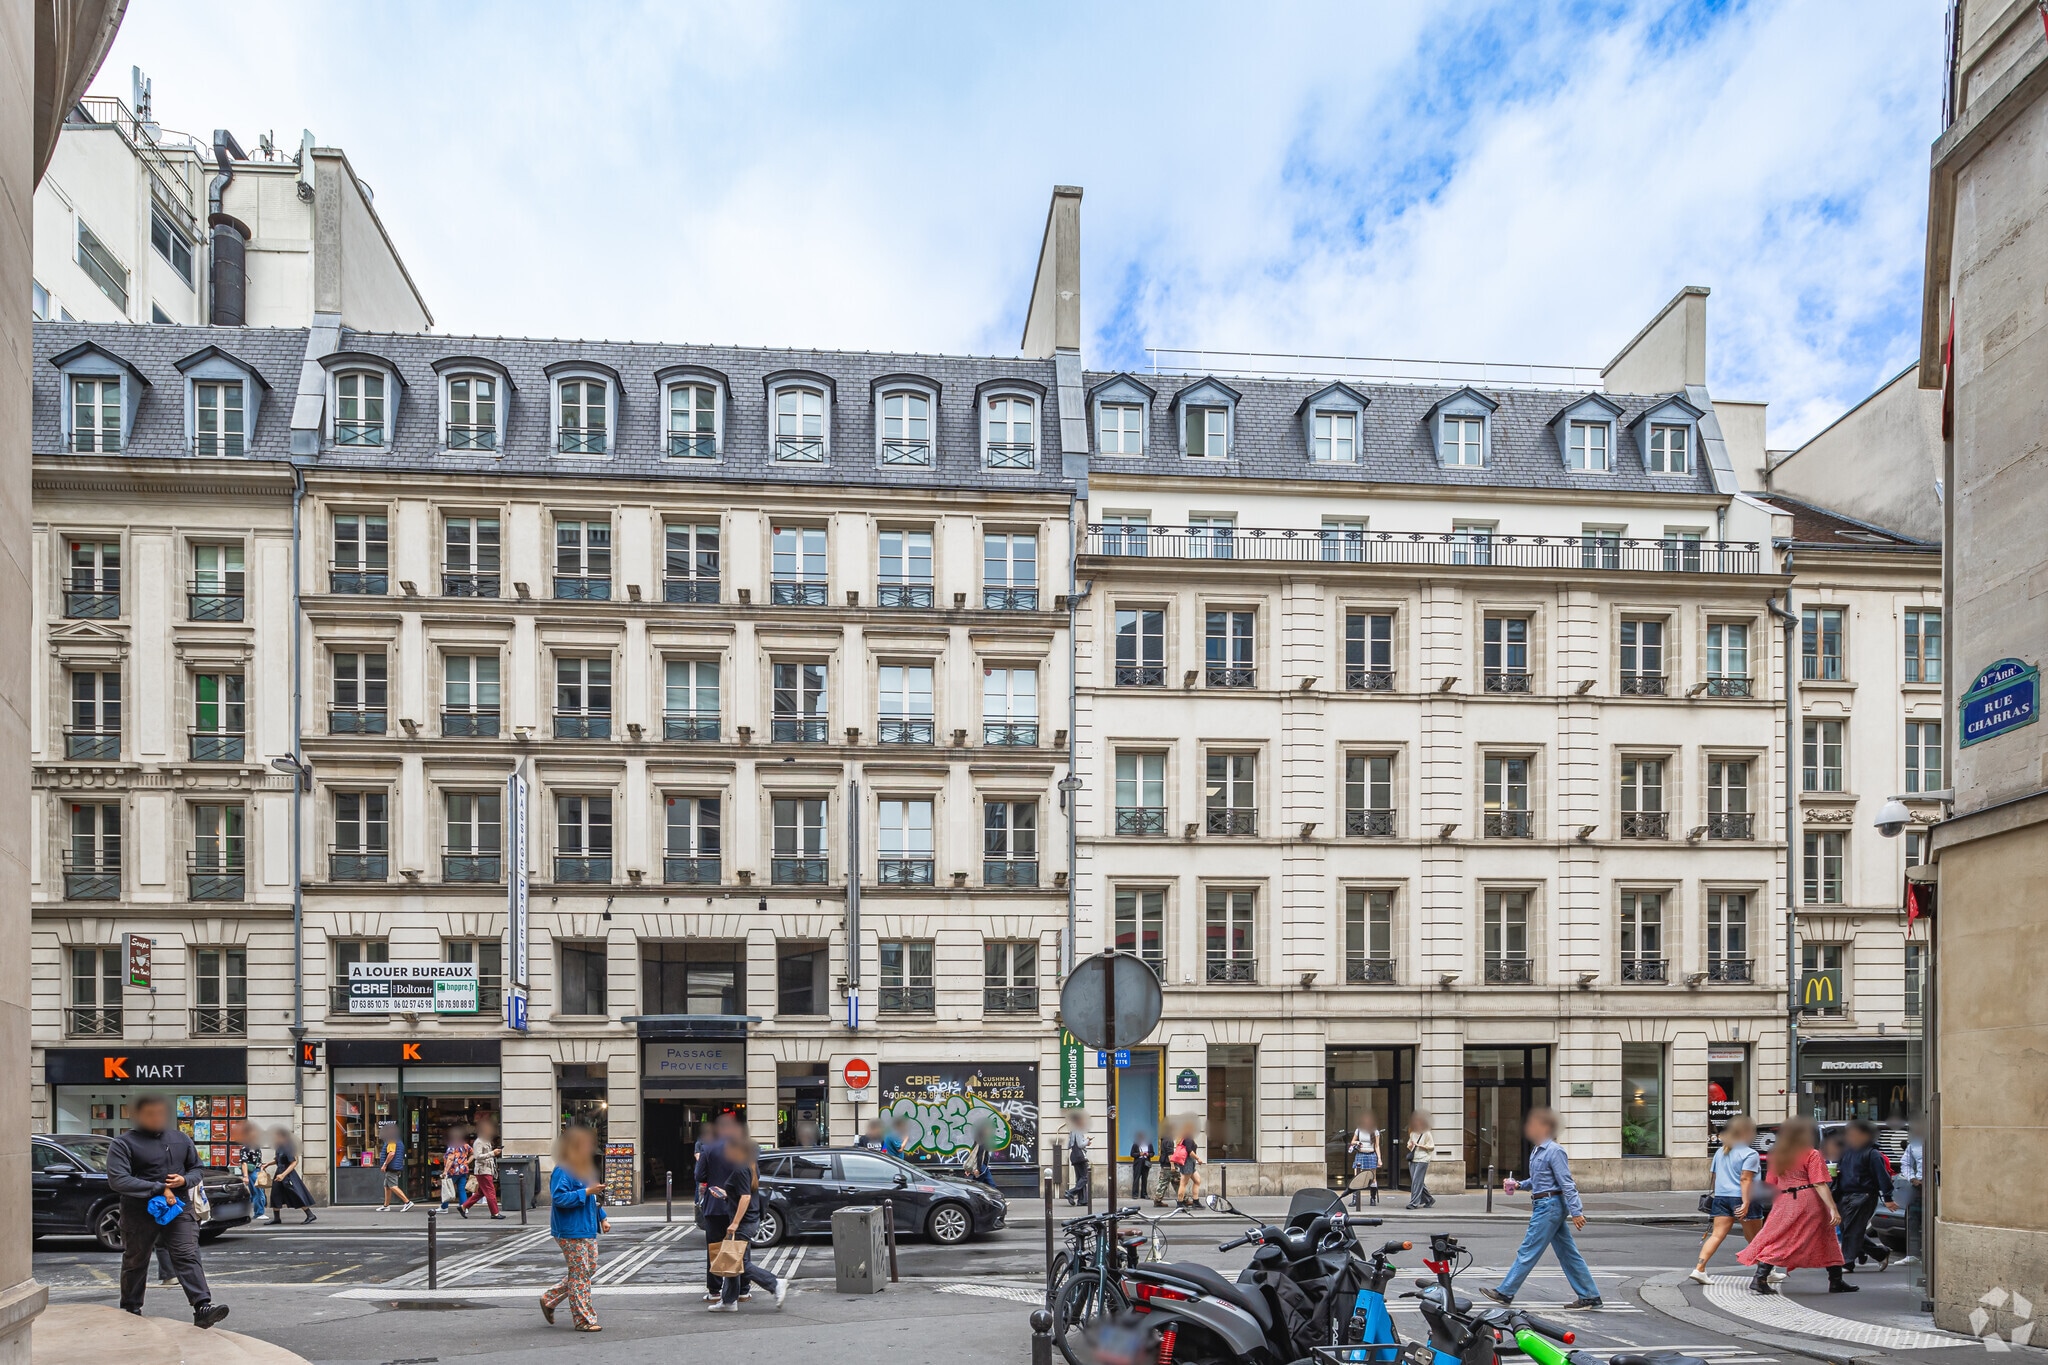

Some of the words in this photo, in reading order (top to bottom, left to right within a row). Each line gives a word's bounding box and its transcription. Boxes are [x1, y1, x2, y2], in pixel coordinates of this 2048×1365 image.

[1984, 694, 2013, 714] RUE
[1967, 702, 2030, 733] CHARRAS
[131, 937, 149, 949] Soupe
[352, 967, 362, 977] A
[366, 967, 407, 977] LOUER
[412, 967, 473, 977] BUREAUX
[351, 983, 389, 994] CBRE
[396, 983, 432, 994] Bolton.fr
[446, 982, 474, 992] bnppre.fr
[351, 1000, 358, 1008] 07
[359, 1000, 366, 1008] 63
[393, 1000, 401, 1008] 06
[402, 1000, 408, 1008] 02
[409, 1000, 416, 1008] 57
[417, 1000, 424, 1008] 45
[304, 1044, 313, 1060] K
[402, 1043, 422, 1060] K
[667, 1048, 722, 1058] PASSAGE
[103, 1057, 129, 1078] K
[136, 1064, 185, 1078] MART
[660, 1061, 728, 1070] PROVENCE
[1821, 1061, 1883, 1070] McDonald's
[1068, 1050, 1077, 1096] McDonald's
[906, 1075, 941, 1085] CBRE
[907, 1091, 915, 1099] 23
[918, 1091, 927, 1099] 25
[978, 1091, 988, 1099] 84
[990, 1091, 1000, 1099] 26
[1002, 1091, 1012, 1099] 52
[1014, 1091, 1024, 1099] 22
